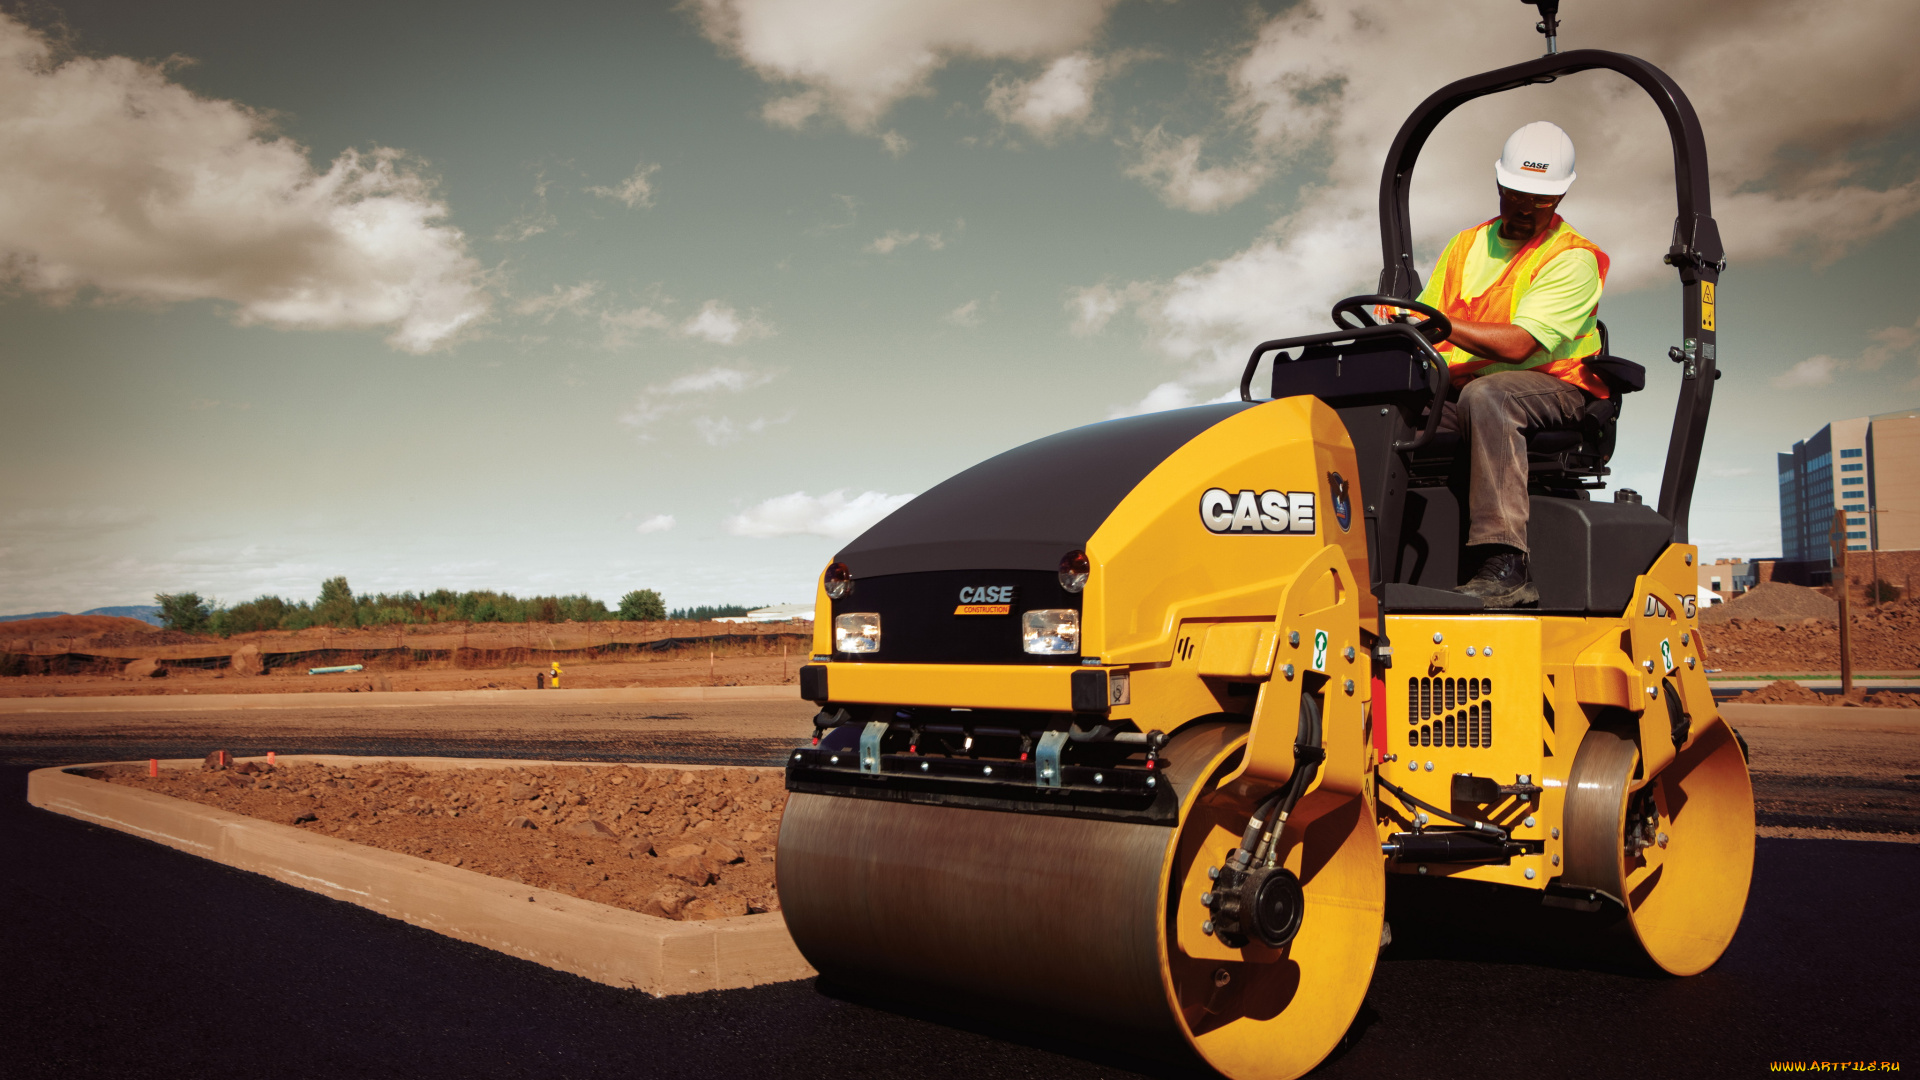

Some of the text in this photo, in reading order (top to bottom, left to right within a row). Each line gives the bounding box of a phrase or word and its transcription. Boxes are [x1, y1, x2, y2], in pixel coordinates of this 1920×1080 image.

[1523, 161, 1549, 169] CASE
[1200, 488, 1315, 532] CASE
[959, 586, 1013, 603] CASE
